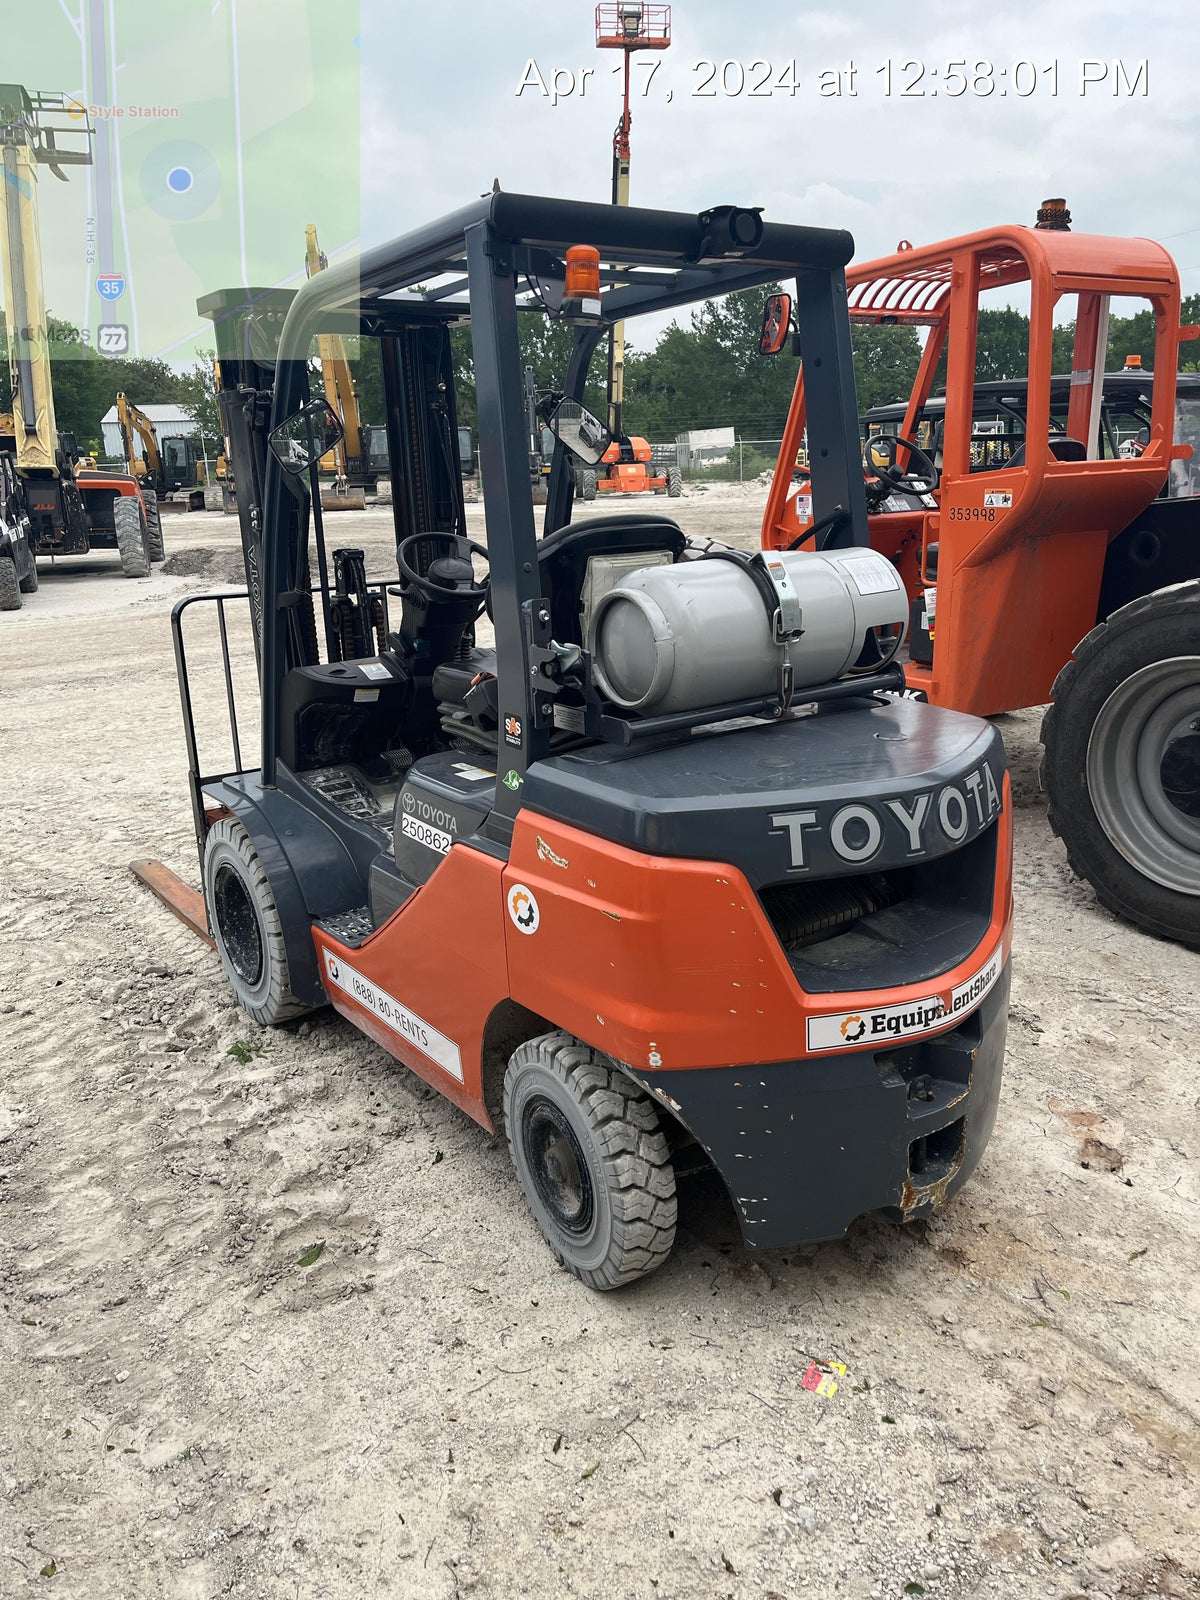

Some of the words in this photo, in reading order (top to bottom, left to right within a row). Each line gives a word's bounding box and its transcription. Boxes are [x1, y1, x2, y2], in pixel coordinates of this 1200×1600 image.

[949, 507, 996, 522] 353998
[505, 717, 522, 737] SAS
[416, 799, 458, 834] TOYOTA
[772, 761, 1002, 872] TOYOTA
[402, 817, 450, 854] 250862
[352, 977, 376, 1009] (888)
[378, 997, 429, 1047] 80-RENTS
